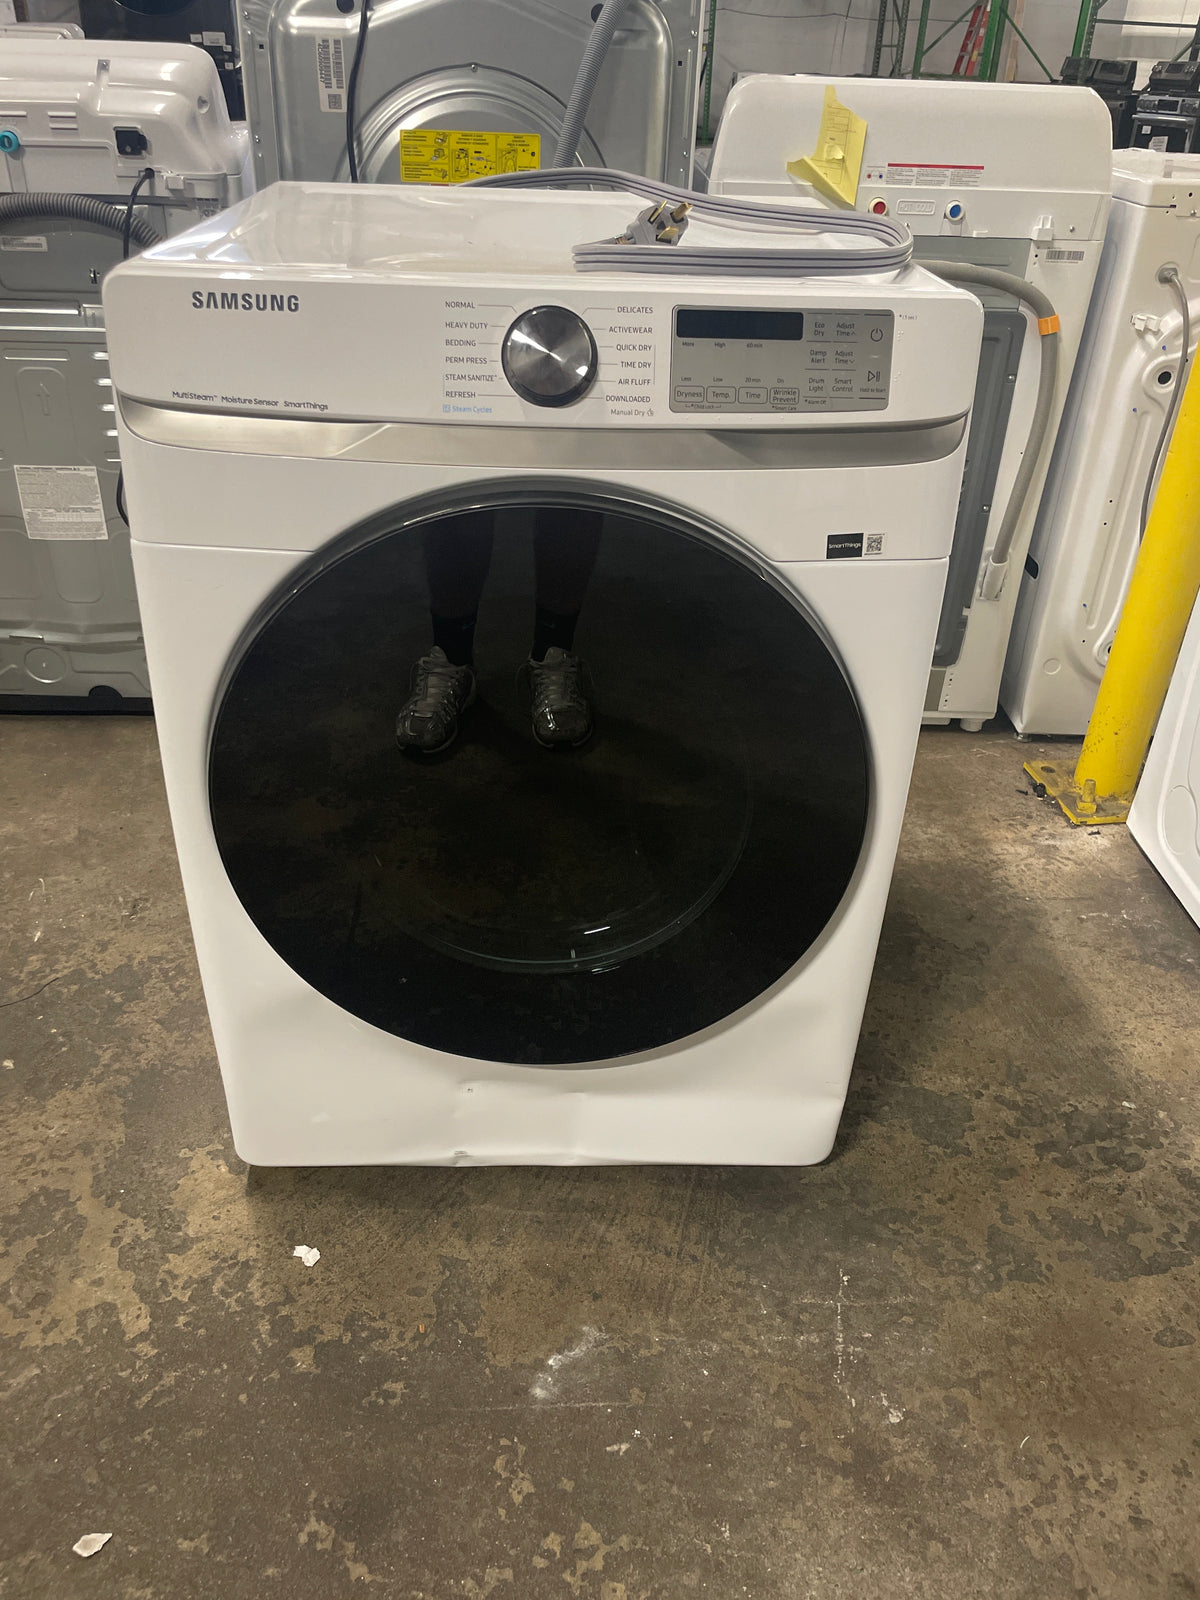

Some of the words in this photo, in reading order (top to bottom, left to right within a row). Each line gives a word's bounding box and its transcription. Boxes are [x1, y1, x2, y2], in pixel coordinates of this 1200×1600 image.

[192, 291, 300, 312] SAMSUNG
[445, 301, 476, 309] NORMAL
[617, 306, 653, 314] DELICATES
[469, 322, 488, 330] DUTY
[608, 326, 653, 334] ACTIVEWEAR
[836, 322, 855, 330] Adjust
[445, 339, 477, 347] BEDDING
[616, 344, 637, 352] QUICK
[835, 350, 854, 358] Adjust
[638, 361, 652, 369] DRY
[677, 390, 703, 398] Dryness
[605, 395, 651, 403] DOWNLOADED
[221, 396, 253, 405] Moisture
[253, 398, 279, 407] Sensor
[283, 401, 329, 412] SmartThings
[452, 405, 472, 413] Steam
[473, 406, 493, 414] Cycles
[610, 408, 633, 416] Manual
[634, 409, 645, 417] Dry
